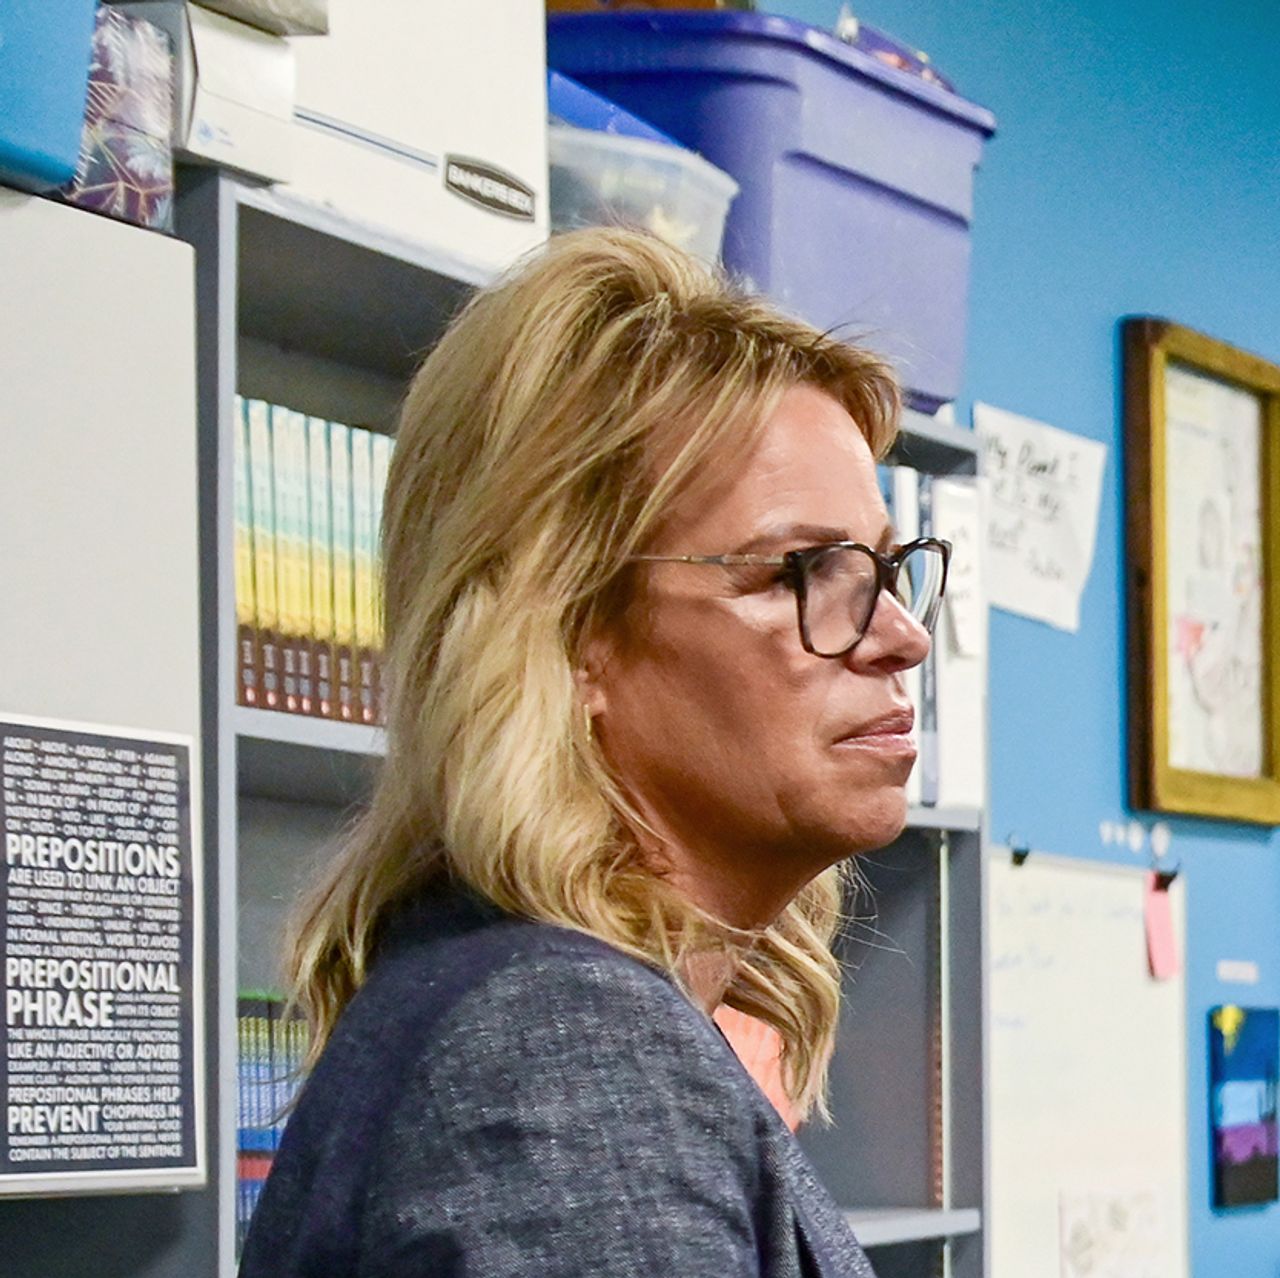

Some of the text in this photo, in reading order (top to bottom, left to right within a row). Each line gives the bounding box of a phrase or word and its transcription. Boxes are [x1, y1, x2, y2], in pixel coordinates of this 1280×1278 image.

[6, 832, 181, 877] PREPOSITIONS
[8, 868, 179, 894] ARE USED TO LINK AN OBJECT
[7, 928, 19, 941] IN
[20, 929, 59, 943] FORMAL
[105, 932, 134, 946] WORK
[136, 934, 149, 947] TO
[150, 934, 179, 948] AVOID
[6, 957, 181, 992] PREPOSITIONAL
[6, 990, 114, 1027] PHRASE
[8, 1043, 180, 1059] LIKE AN ADJECTIVE OR ADVERB
[8, 1086, 182, 1103] PREPOSITIONAL PHRASES HELP
[8, 1104, 100, 1133] PREVENT
[102, 1104, 182, 1120] CHOPPINESS IN
[9, 1144, 183, 1161] CONTAIN THE SUBJECT OF THE SENTENCE
